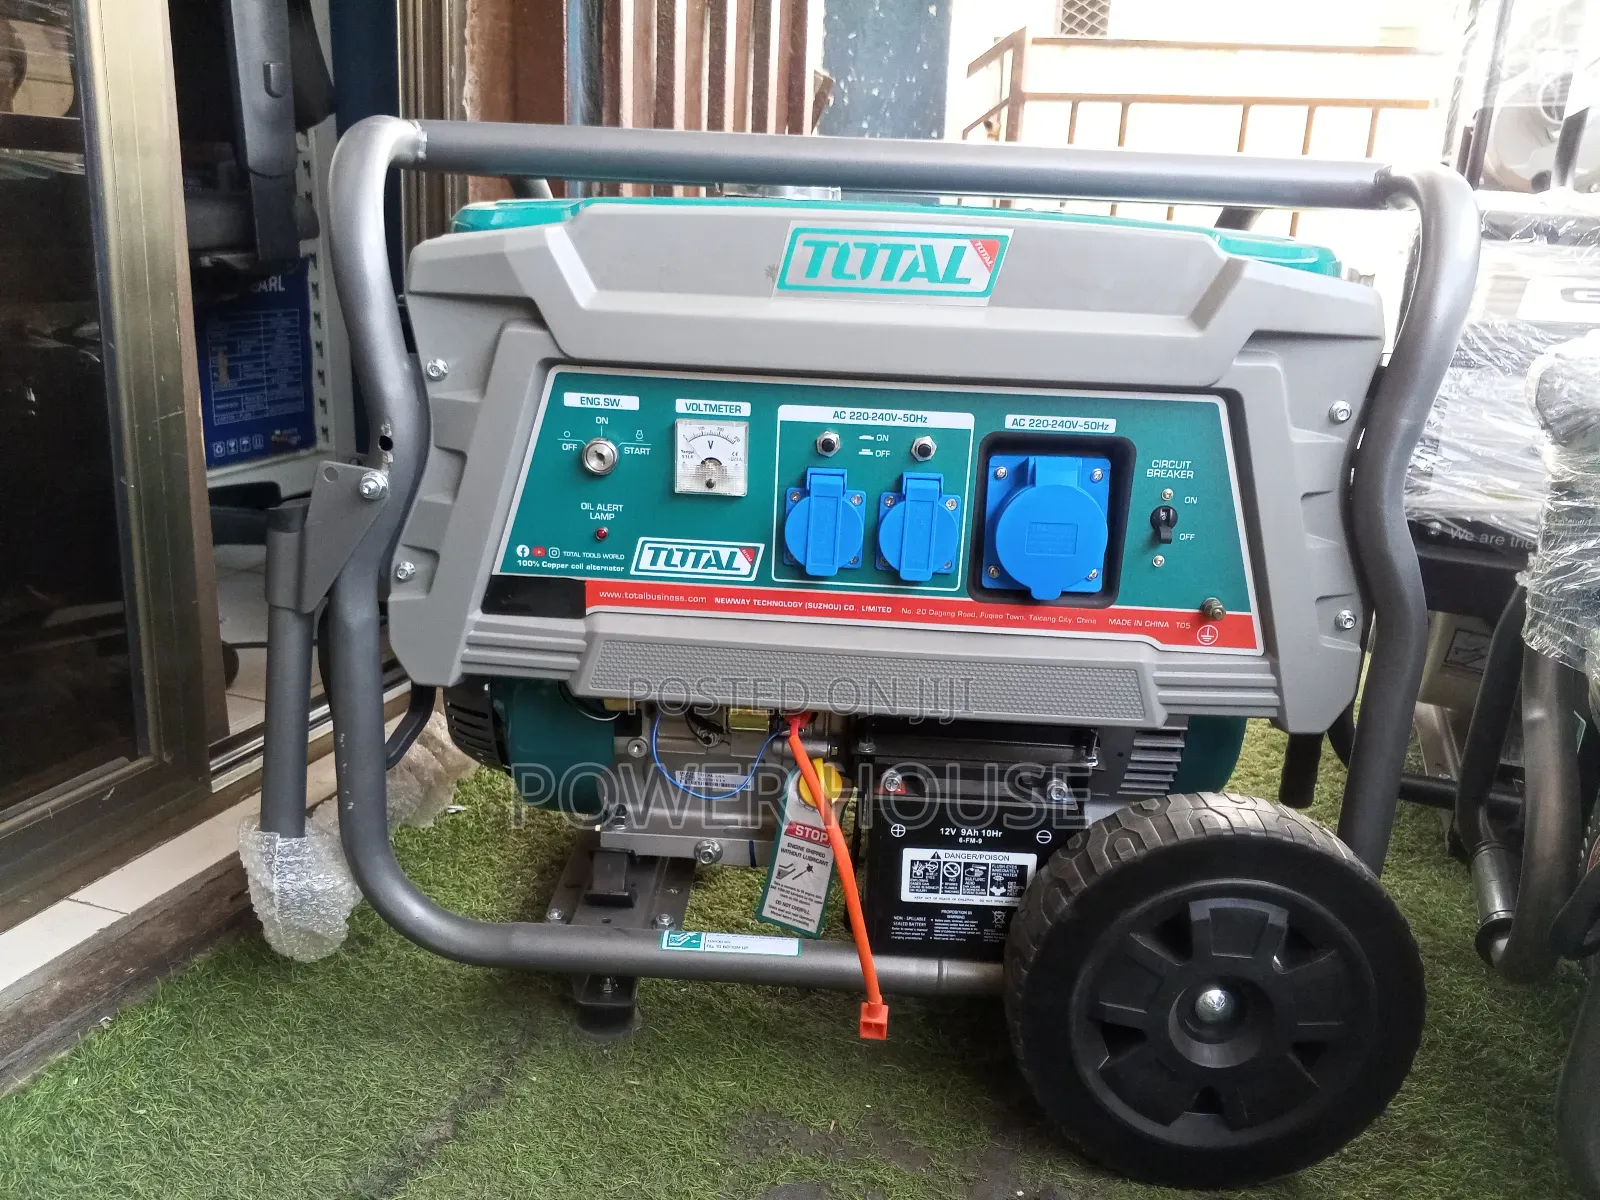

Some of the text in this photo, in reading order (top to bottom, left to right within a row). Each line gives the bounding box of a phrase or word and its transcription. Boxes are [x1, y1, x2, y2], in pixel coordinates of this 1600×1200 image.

[974, 239, 995, 268] TOTAL
[803, 240, 971, 285] TOTAL
[580, 396, 623, 408] ENG.SW.
[685, 402, 742, 414] VOLTMETER
[832, 410, 847, 420] AC
[595, 416, 609, 425] ON
[1011, 418, 1027, 428] AC
[876, 434, 889, 442] ON
[561, 443, 578, 452] OFF
[707, 440, 714, 450] V
[623, 446, 652, 456] START
[875, 450, 891, 458] OFF
[1151, 459, 1192, 470] CIRCUIT
[1146, 468, 1195, 479] BREAKER
[1184, 496, 1198, 505] ON
[580, 502, 624, 513] OIL ALERT
[589, 512, 615, 521] LAMP
[1178, 532, 1196, 541] OFF
[1480, 533, 1505, 546] are
[582, 551, 602, 559] TOOLS
[602, 552, 625, 560] WORLD
[647, 546, 741, 572] TOTAL
[517, 559, 540, 568] 100%
[542, 560, 569, 570] Copper
[586, 563, 625, 572] alternator
[714, 596, 751, 606] NEWWAY
[753, 599, 803, 609] TECHNOLOGY
[805, 602, 842, 611] (SUZHOU)
[861, 605, 892, 614] LIMITED
[901, 607, 915, 615] No.
[916, 607, 927, 616] 20
[1029, 614, 1057, 624] Taicang
[1076, 616, 1097, 625] China
[1108, 618, 1132, 627] MADE
[1133, 619, 1143, 627] IN
[1144, 619, 1170, 629] CHINA
[795, 825, 829, 843] STOP
[939, 827, 1003, 838] 12V 9Ah 10Hr
[787, 842, 805, 852] ENGINE
[780, 847, 802, 858] WITHOUT
[944, 852, 1010, 862] DANGER/POISON
